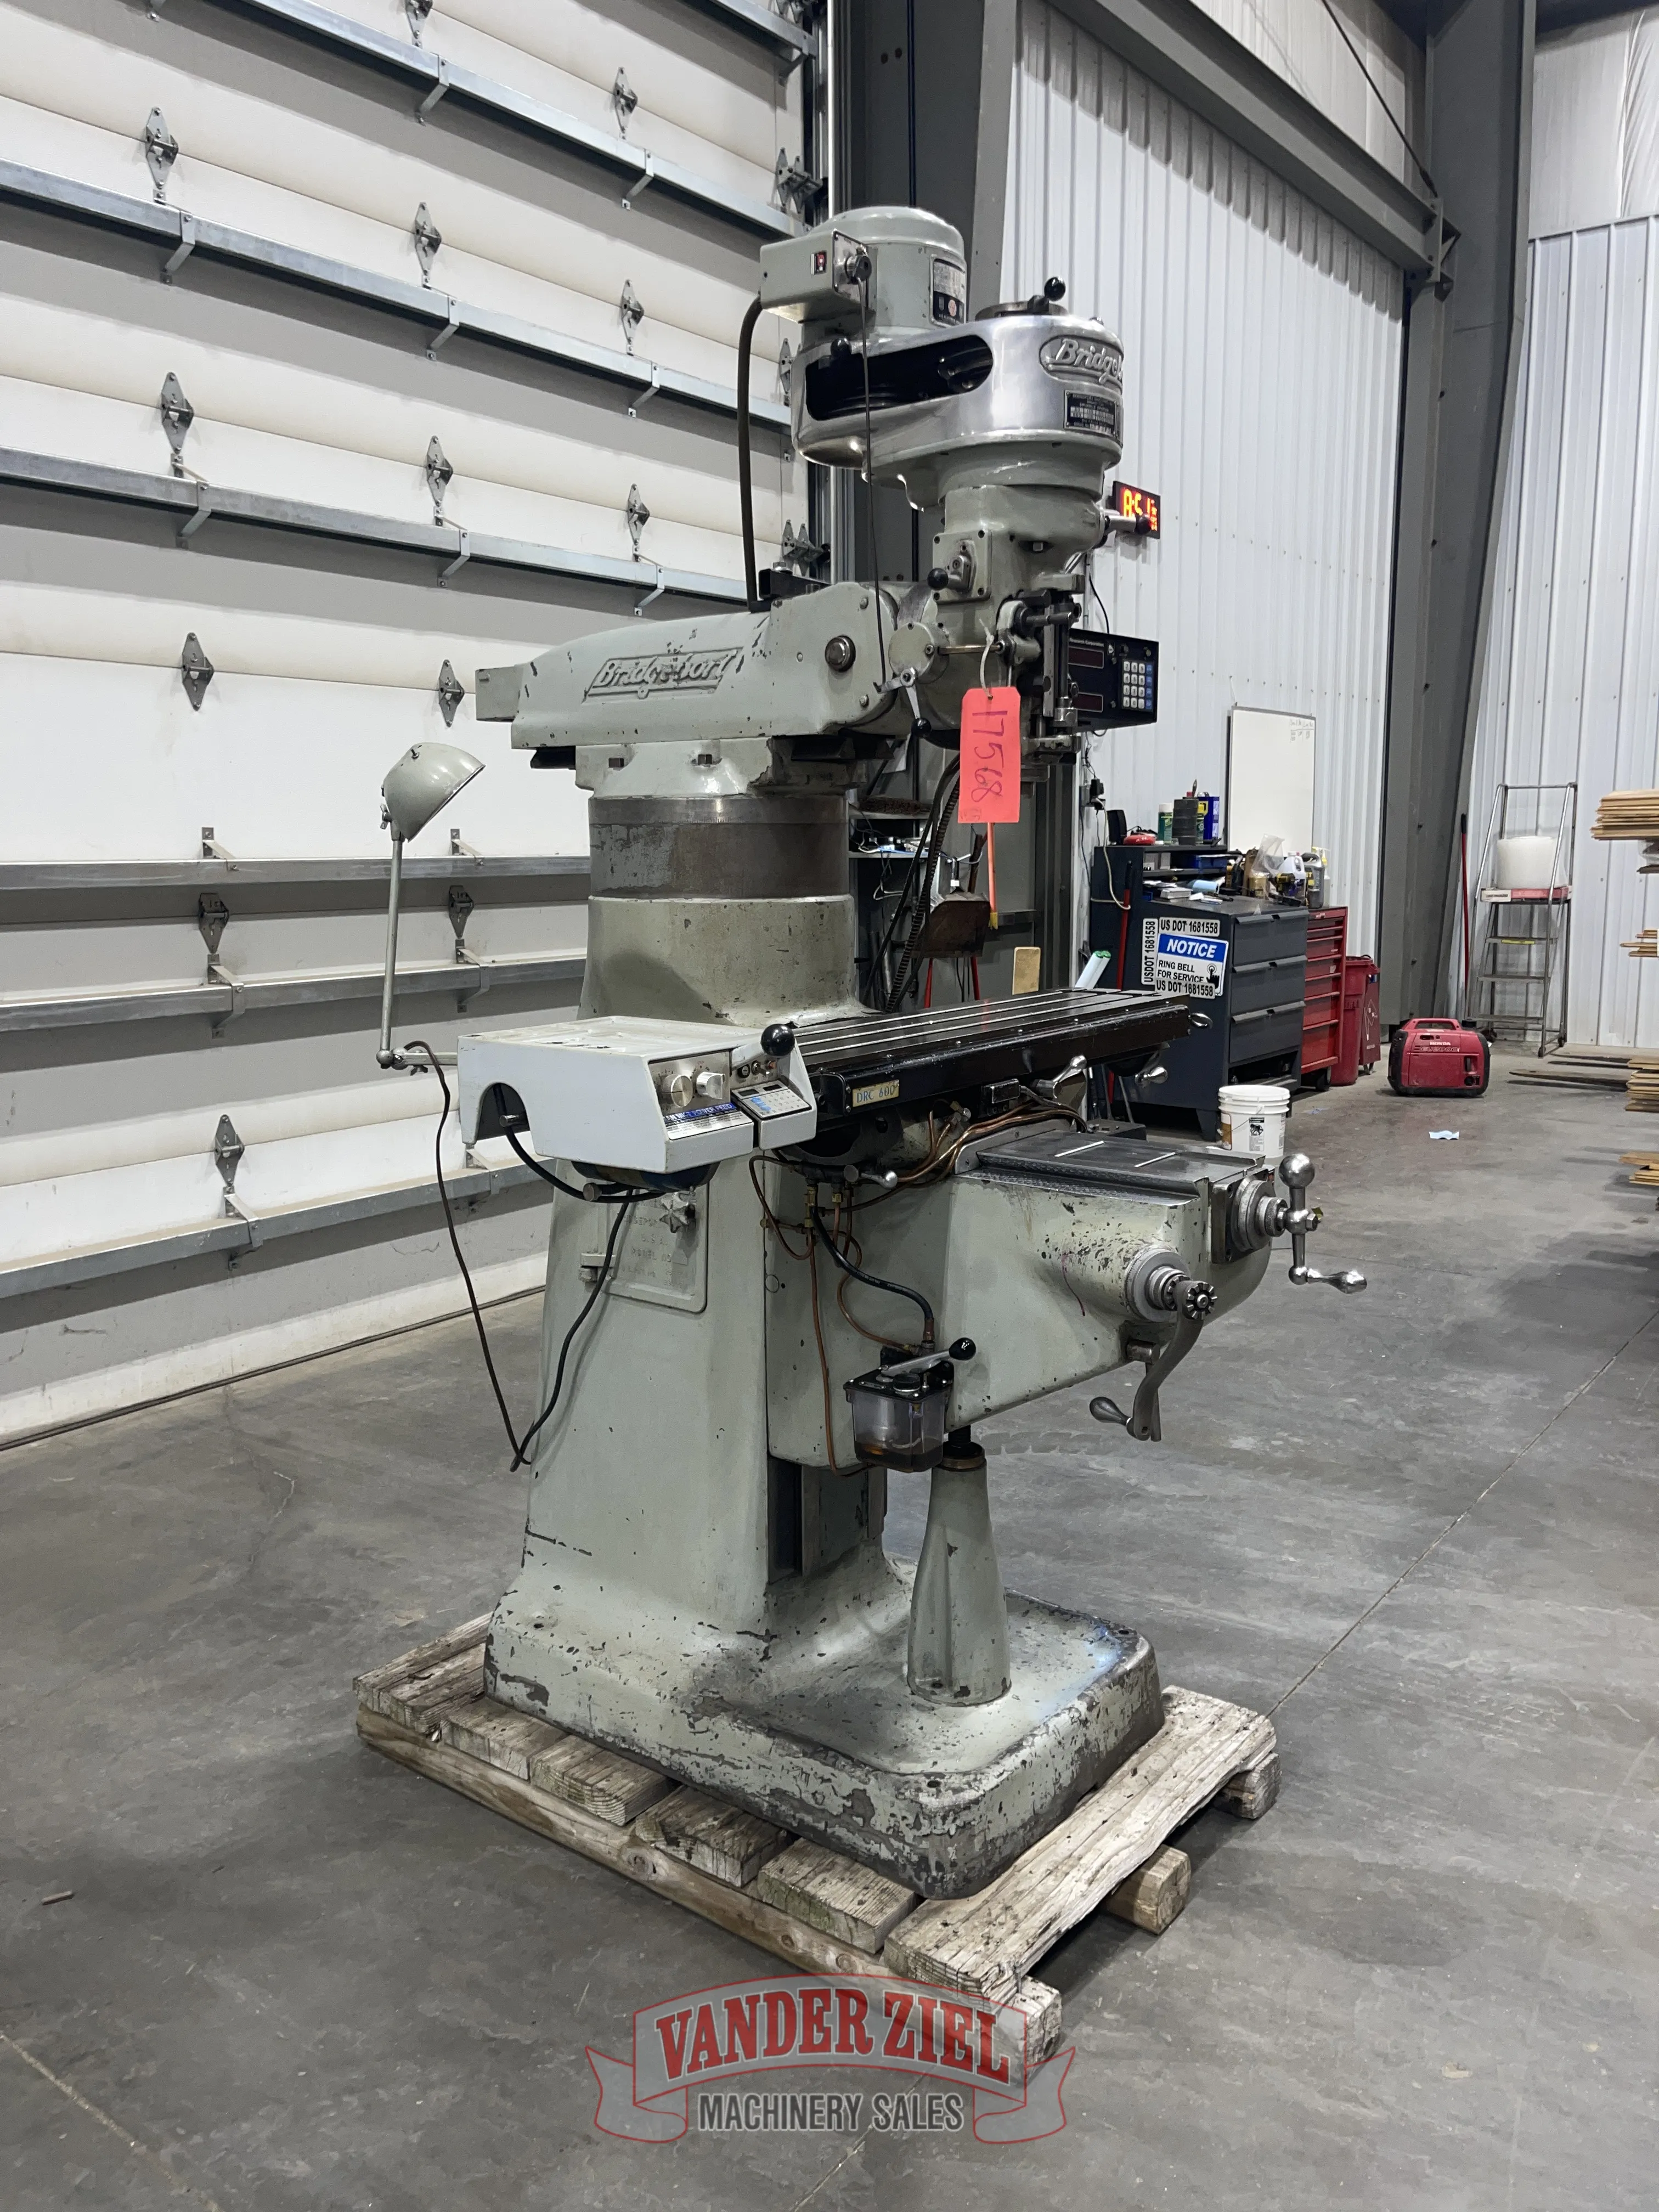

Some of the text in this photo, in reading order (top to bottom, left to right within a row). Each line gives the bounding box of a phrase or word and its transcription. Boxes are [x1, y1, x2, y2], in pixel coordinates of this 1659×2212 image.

[971, 710, 1008, 802] 17568
[1161, 919, 1218, 934] US DOT 1681558
[1145, 921, 1155, 952] 1681558
[1166, 939, 1217, 958] NOTICE
[1159, 960, 1195, 973] RING BELL
[1157, 969, 1204, 983] FOR SERVICE
[1156, 980, 1166, 991] US
[1168, 981, 1182, 993] DOT
[857, 1084, 895, 1103] DRC 600
[692, 1107, 716, 1116] POWER
